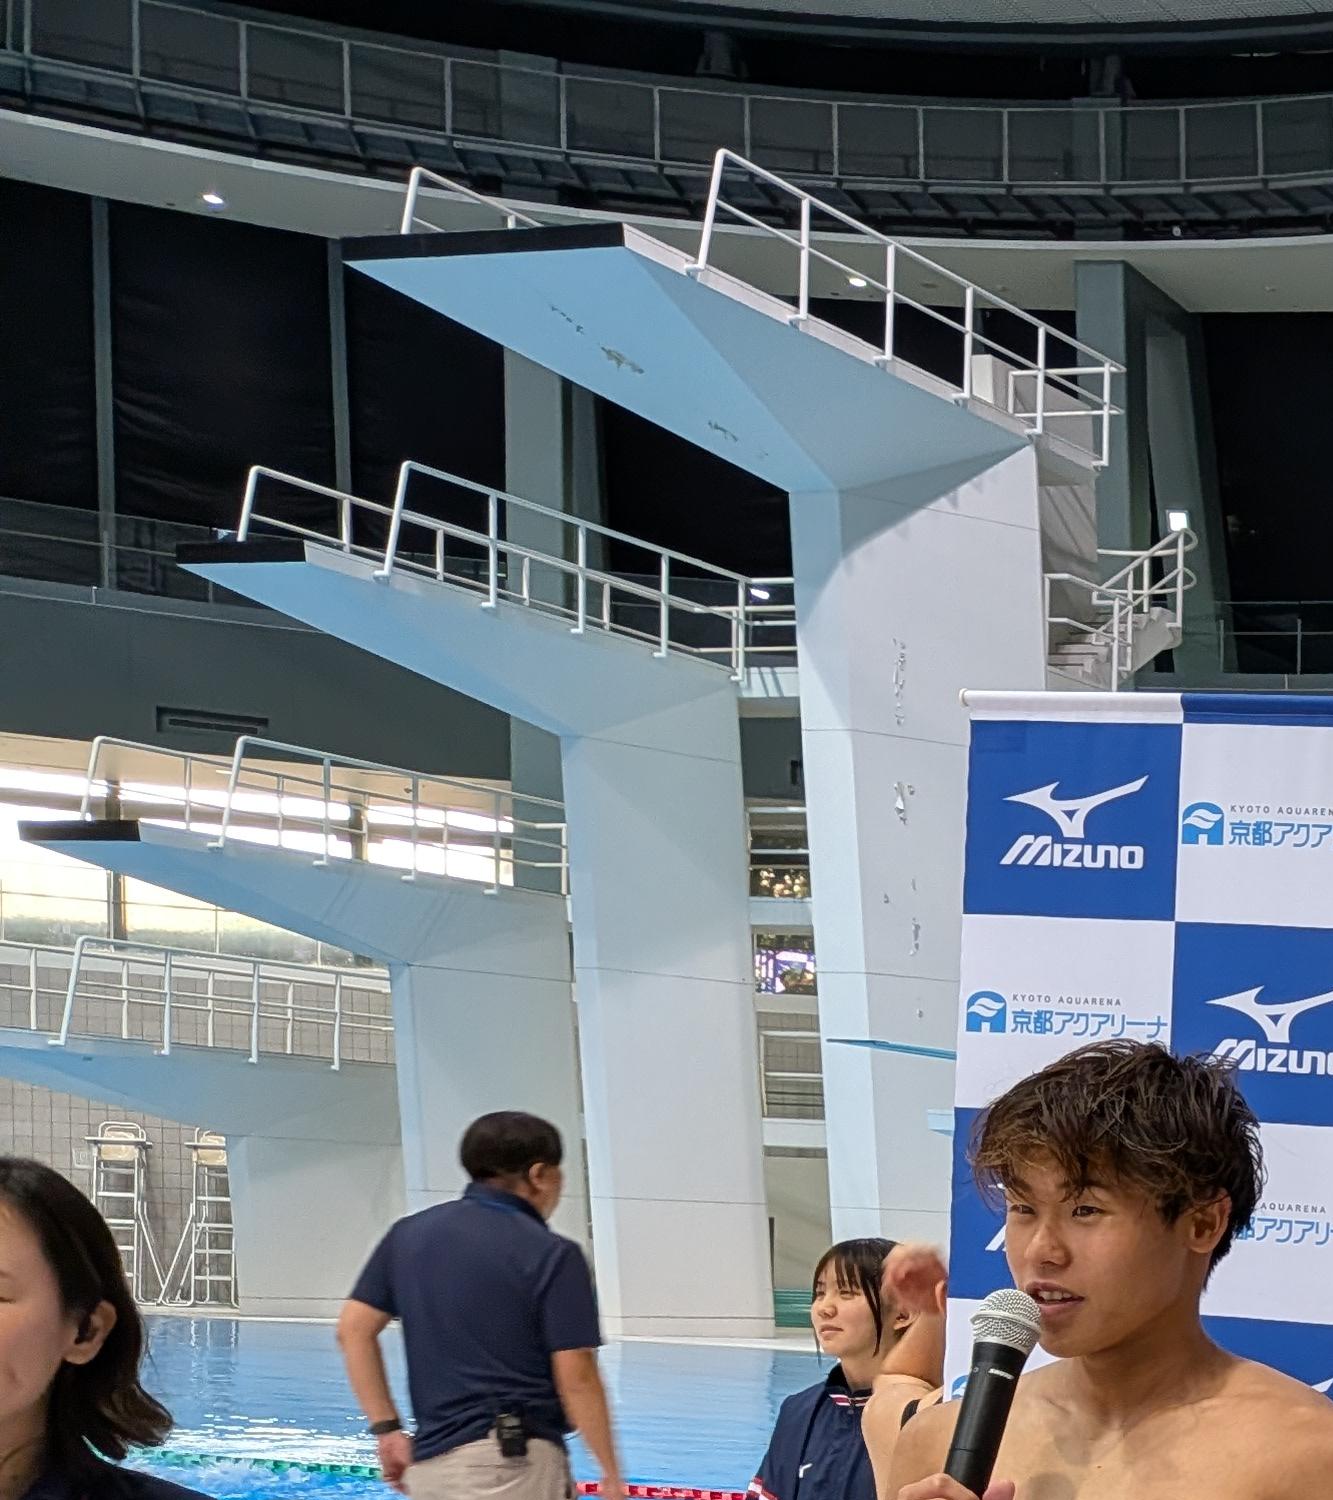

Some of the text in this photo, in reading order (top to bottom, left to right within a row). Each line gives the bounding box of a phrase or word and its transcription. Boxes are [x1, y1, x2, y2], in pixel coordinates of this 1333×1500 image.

[1230, 805, 1271, 816] KYOTO
[1000, 835, 1144, 870] MIZUNO
[1012, 993, 1122, 1007] KYOTO AQUARENA
[1011, 1009, 1169, 1039] 京都アクアリーナ
